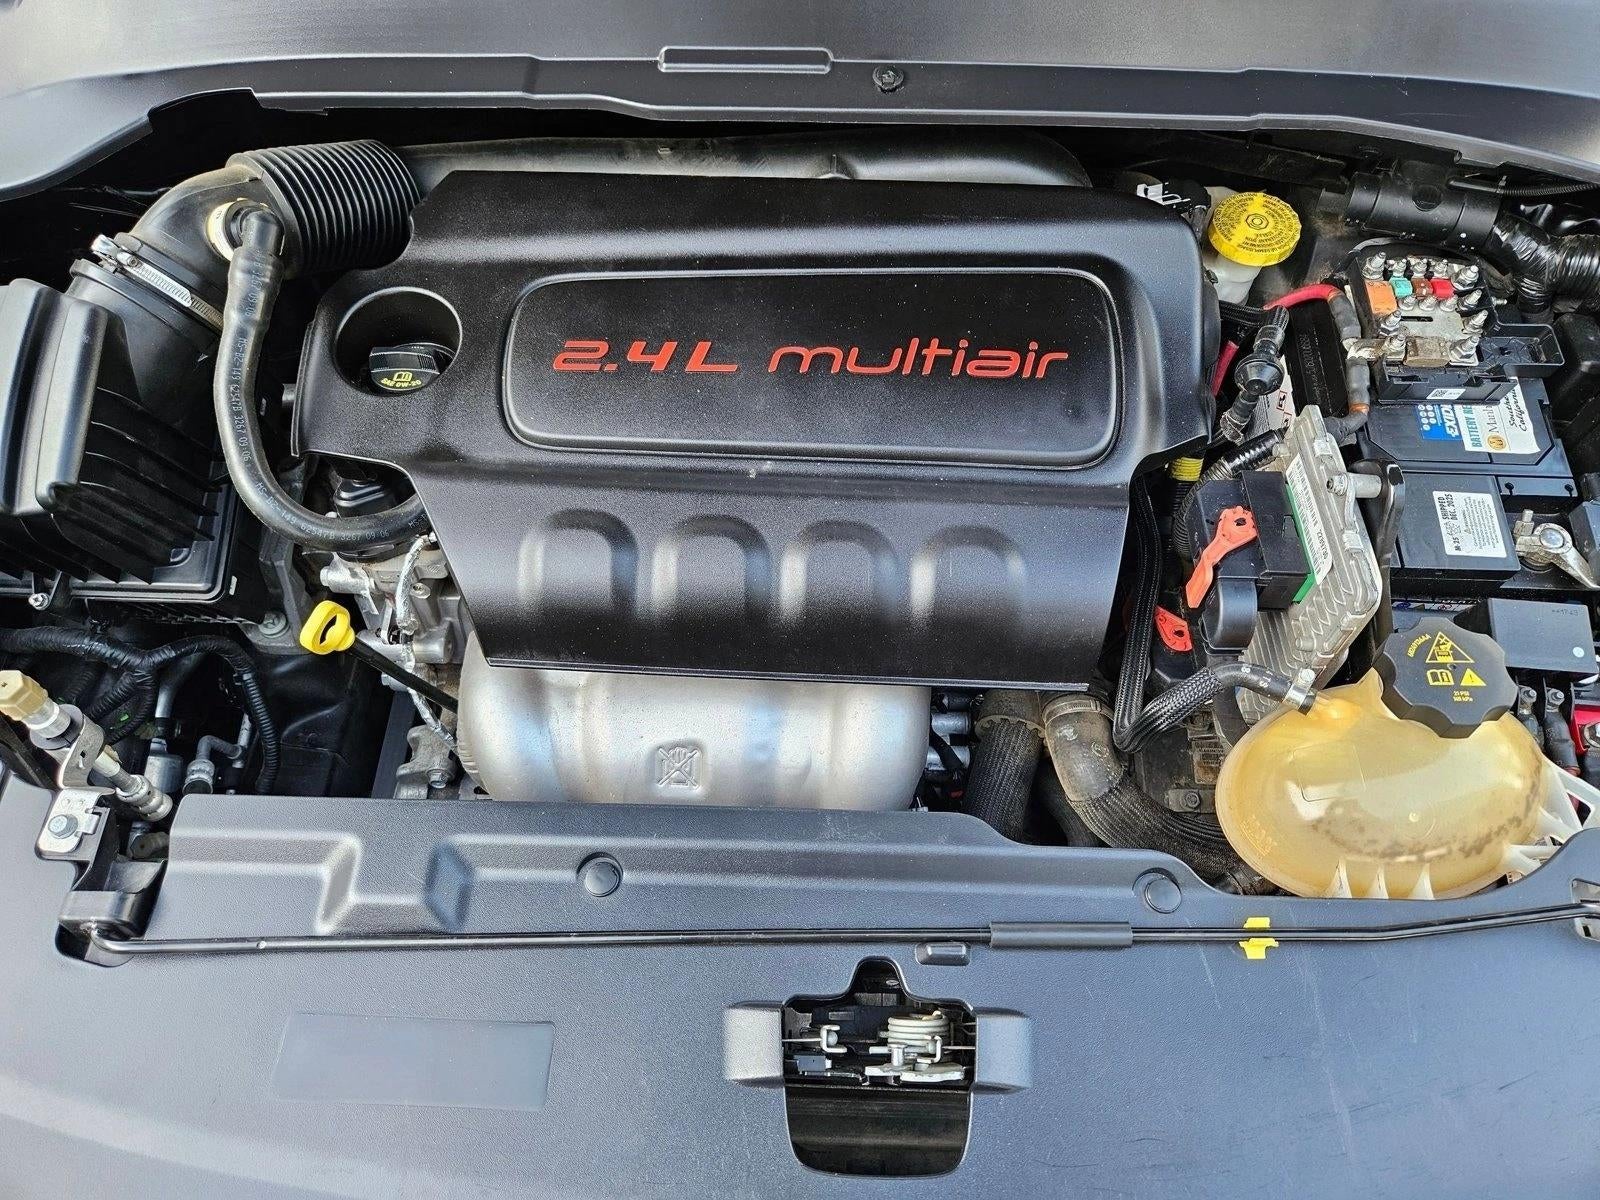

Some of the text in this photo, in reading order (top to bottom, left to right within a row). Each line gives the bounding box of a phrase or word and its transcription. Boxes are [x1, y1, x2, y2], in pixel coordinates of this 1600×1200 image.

[768, 337, 1068, 379] multiair
[381, 377, 422, 388] SAE 0W-20
[234, 415, 248, 433] 3267
[1465, 416, 1482, 448] BATTERY
[1437, 496, 1449, 520] SHIPPED
[1444, 493, 1456, 508] 2025
